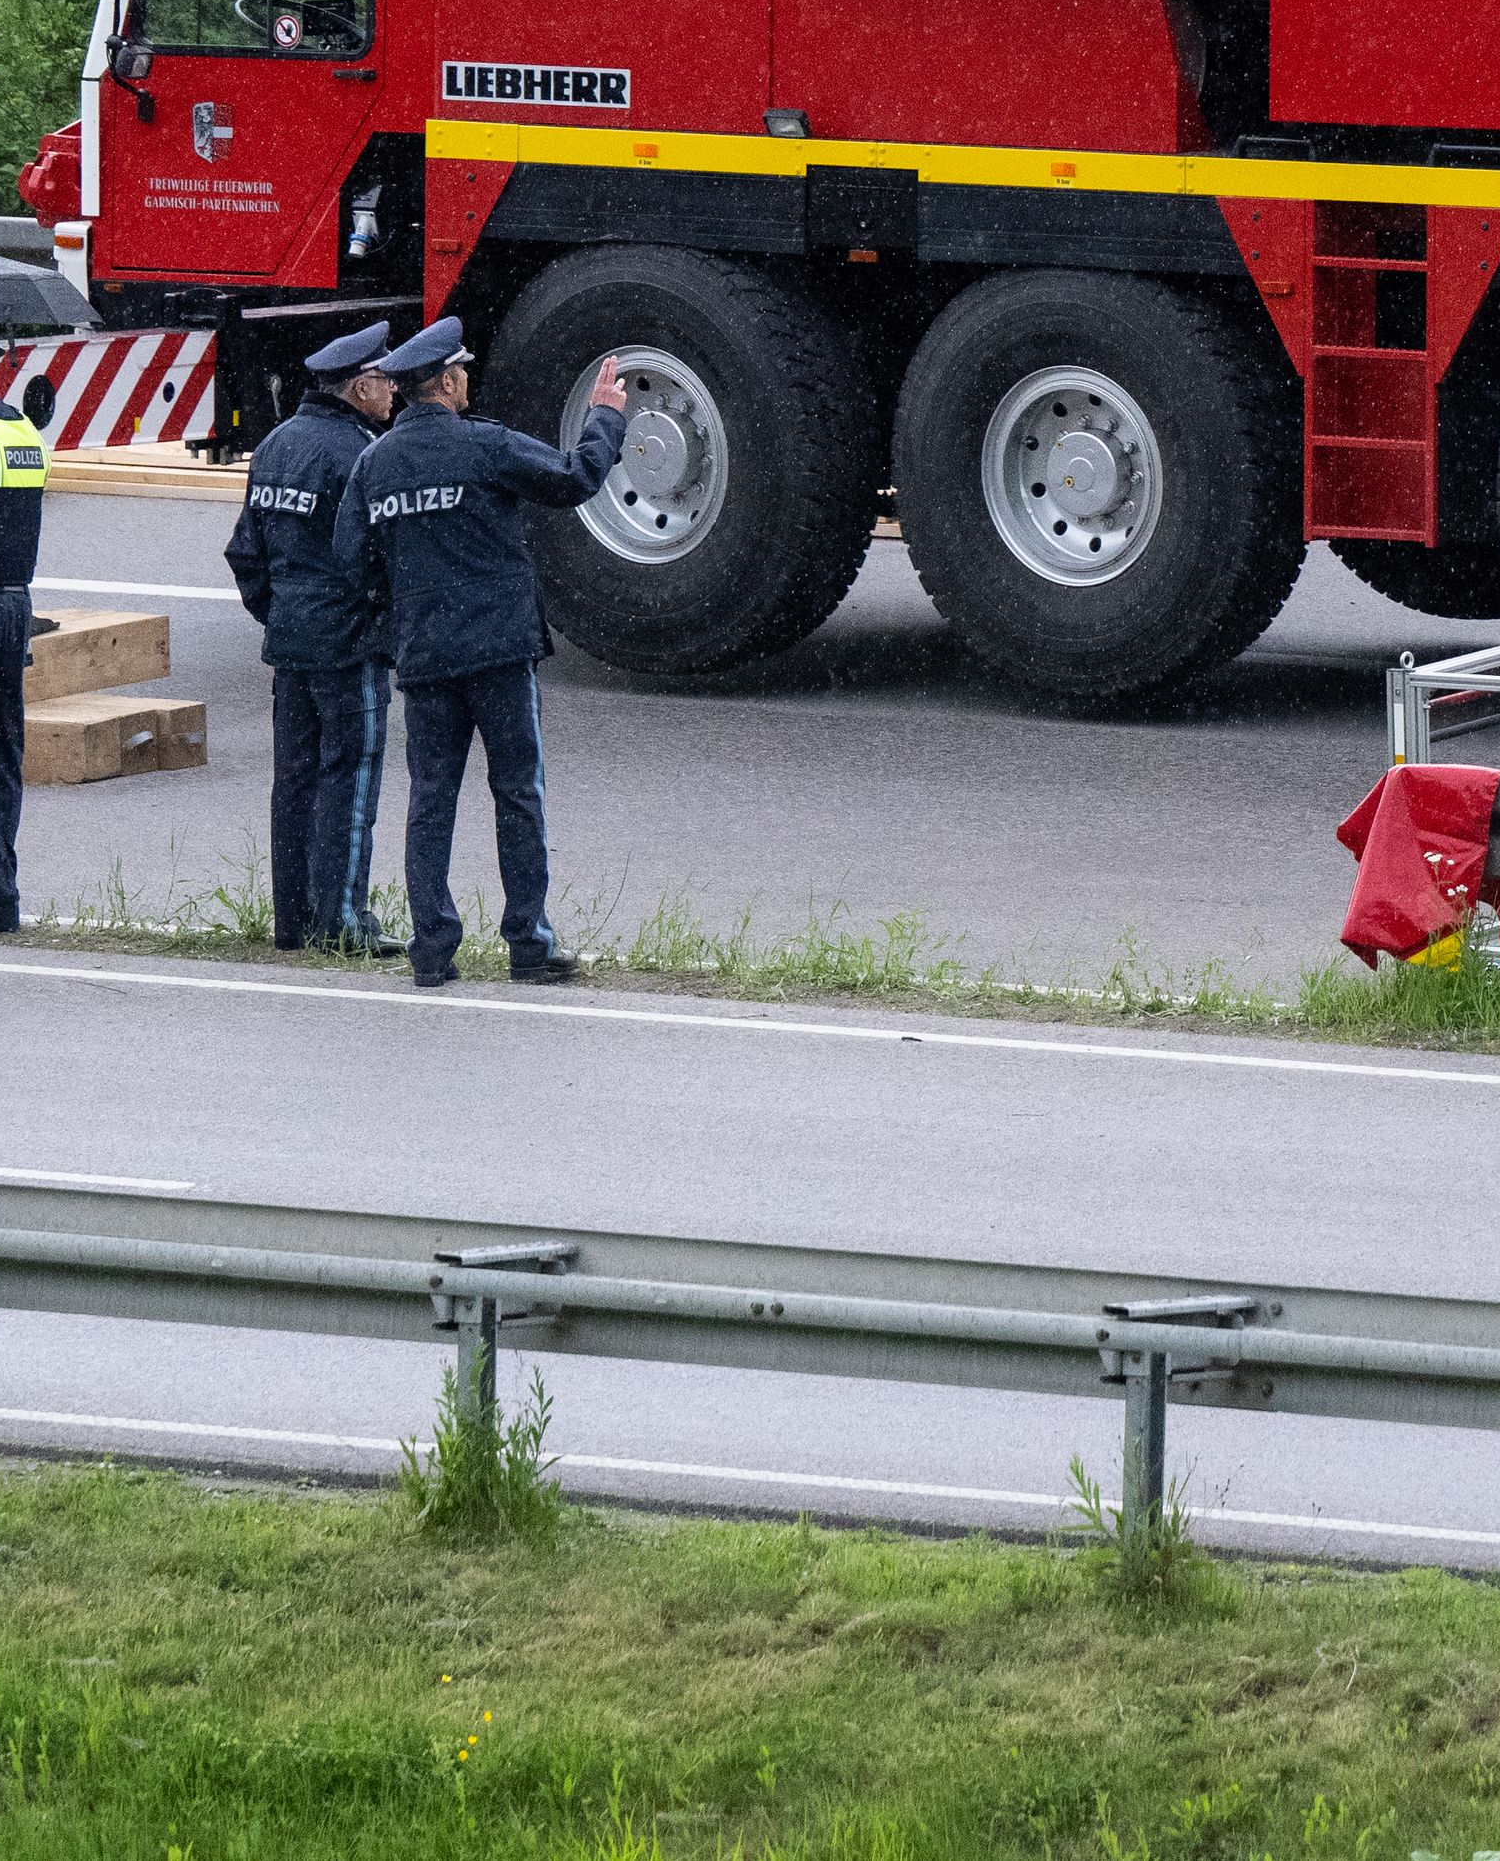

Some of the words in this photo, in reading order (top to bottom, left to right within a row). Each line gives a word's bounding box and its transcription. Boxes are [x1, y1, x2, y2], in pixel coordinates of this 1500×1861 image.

[446, 65, 627, 105] LIEBHERR
[149, 177, 210, 192] FREIWILLIGE
[213, 180, 274, 195] FEUERWEHR
[144, 196, 280, 213] GARMISCH-PARTENKIRCHEN
[368, 486, 464, 524] POLIZEI
